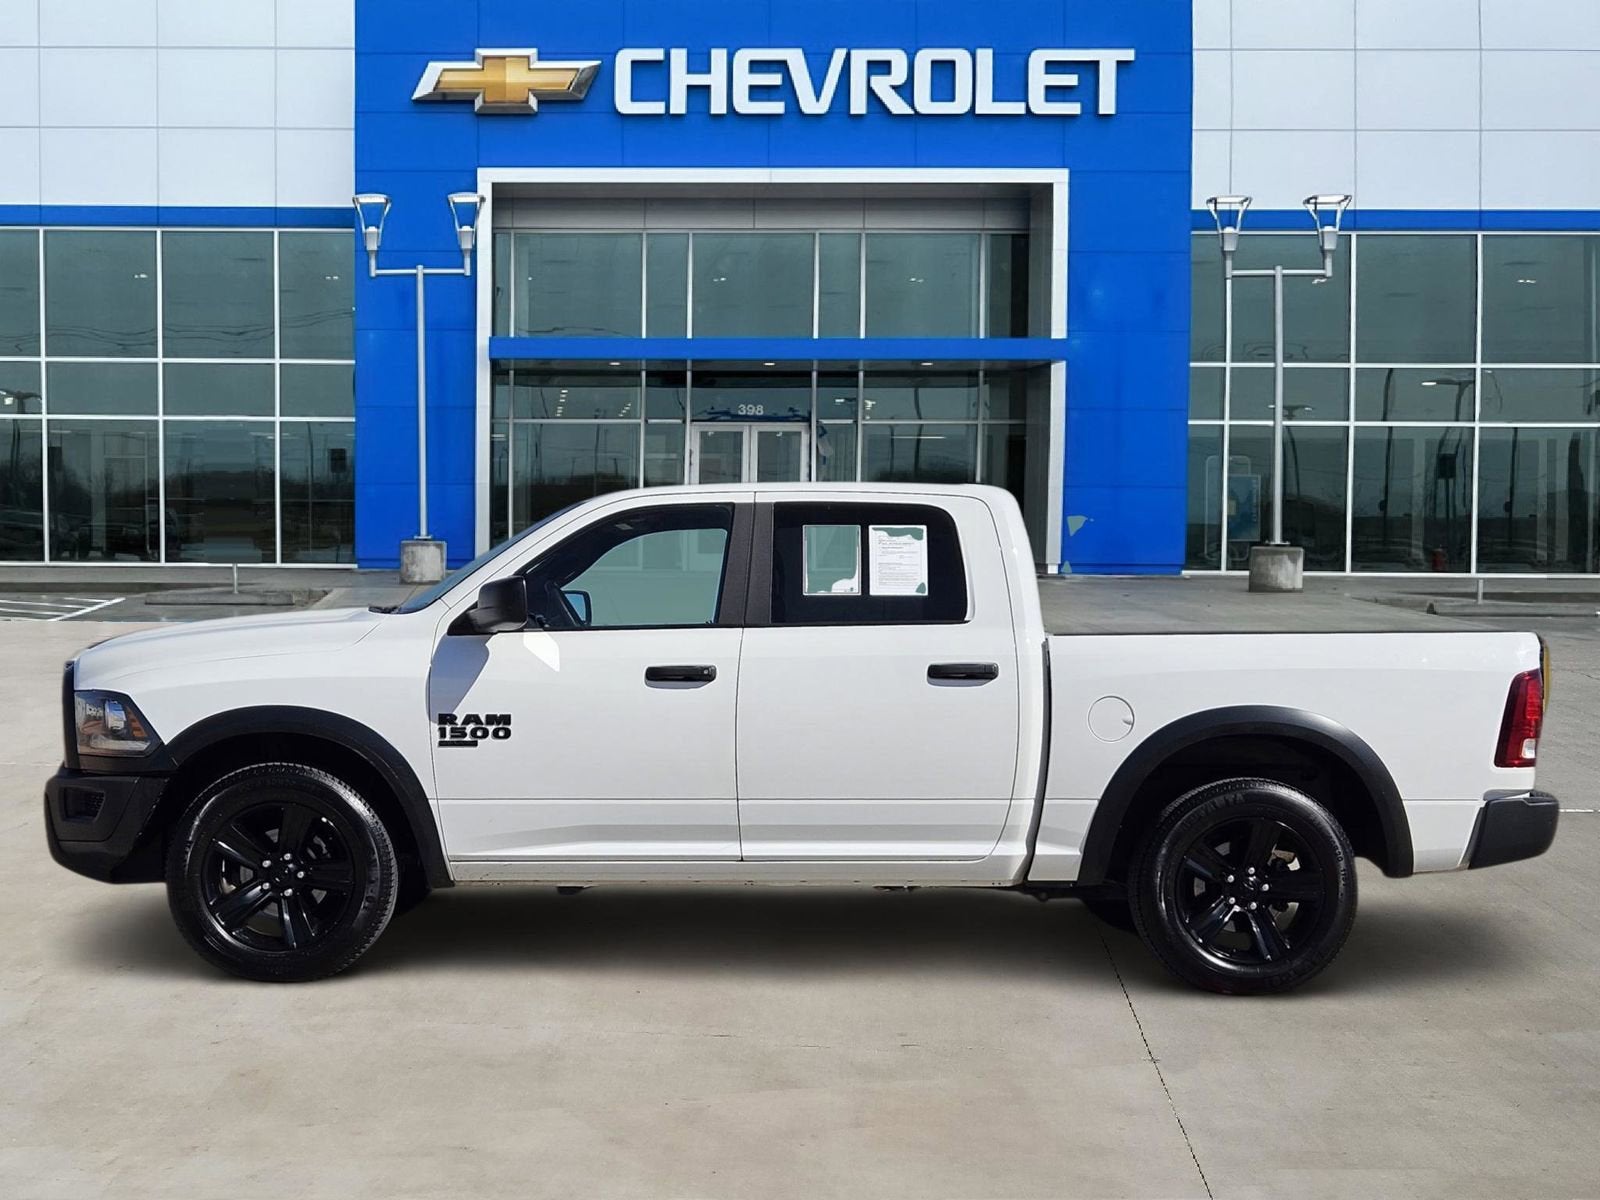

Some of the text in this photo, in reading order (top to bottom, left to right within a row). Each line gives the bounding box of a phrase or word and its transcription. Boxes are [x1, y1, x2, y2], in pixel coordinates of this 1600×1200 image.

[614, 47, 1136, 116] CHEVROLET
[738, 404, 764, 416] 398
[437, 713, 512, 726] RAM
[437, 726, 512, 740] 1500
